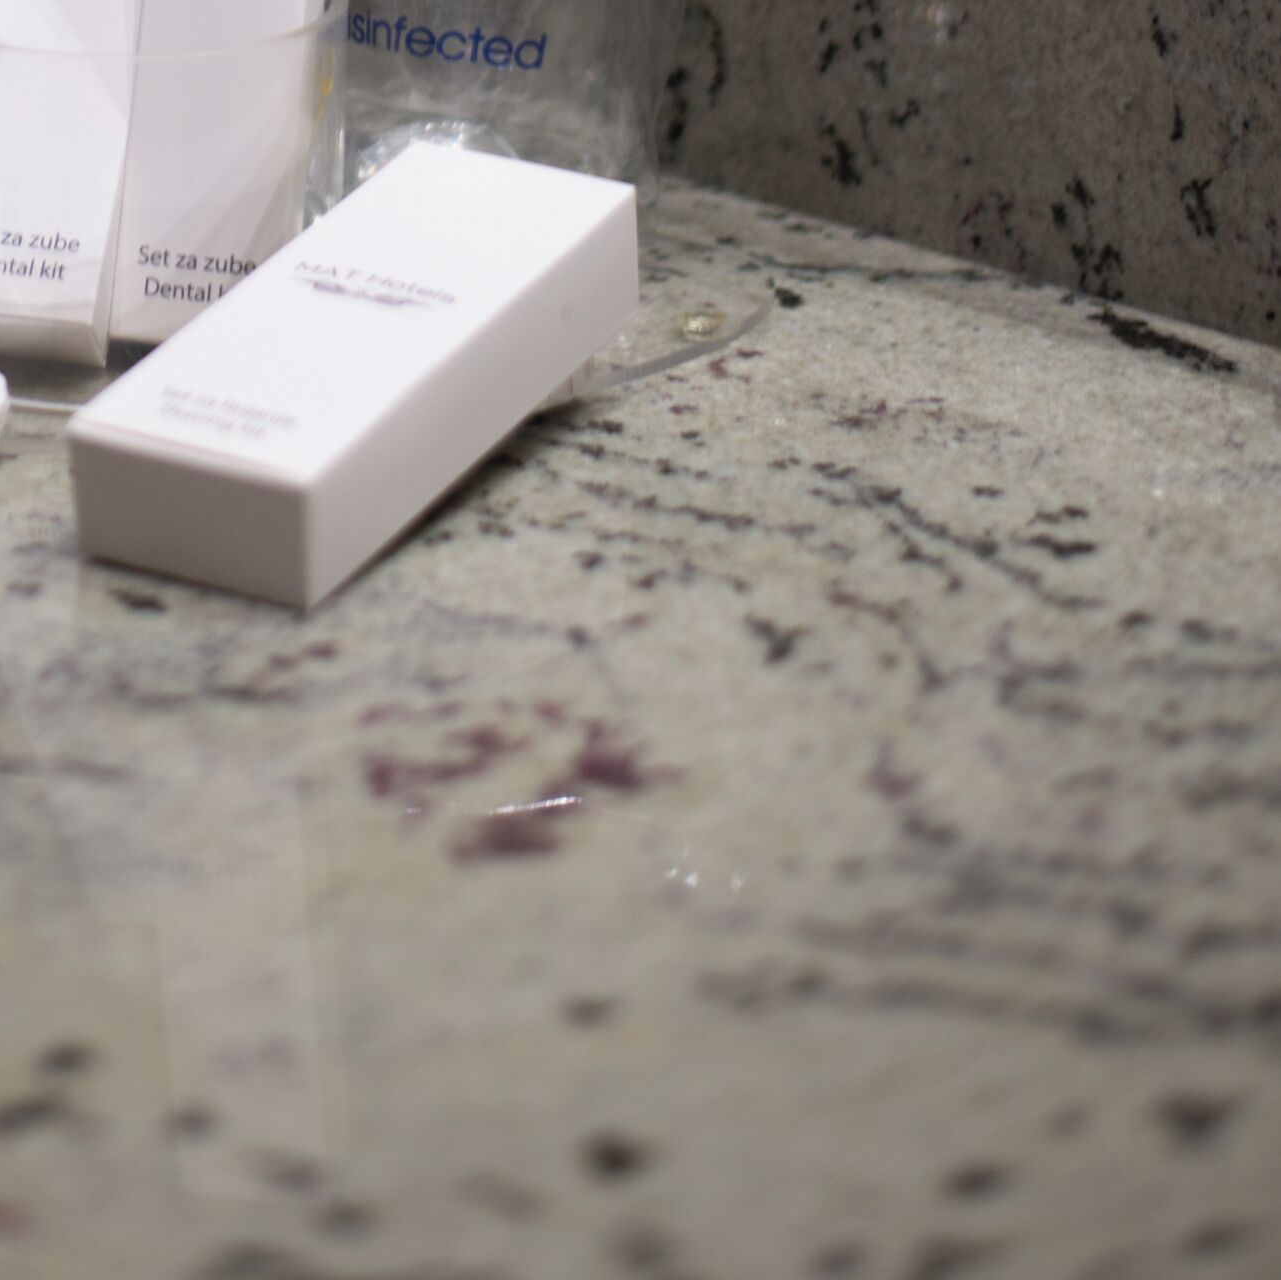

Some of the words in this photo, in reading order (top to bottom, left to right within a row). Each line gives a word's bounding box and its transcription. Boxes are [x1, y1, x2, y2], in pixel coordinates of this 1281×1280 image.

[0, 230, 23, 248] za
[28, 231, 81, 254] zube
[39, 258, 67, 282] kit
[138, 243, 170, 268] Set
[175, 252, 198, 271] za
[143, 275, 213, 303] Dental
